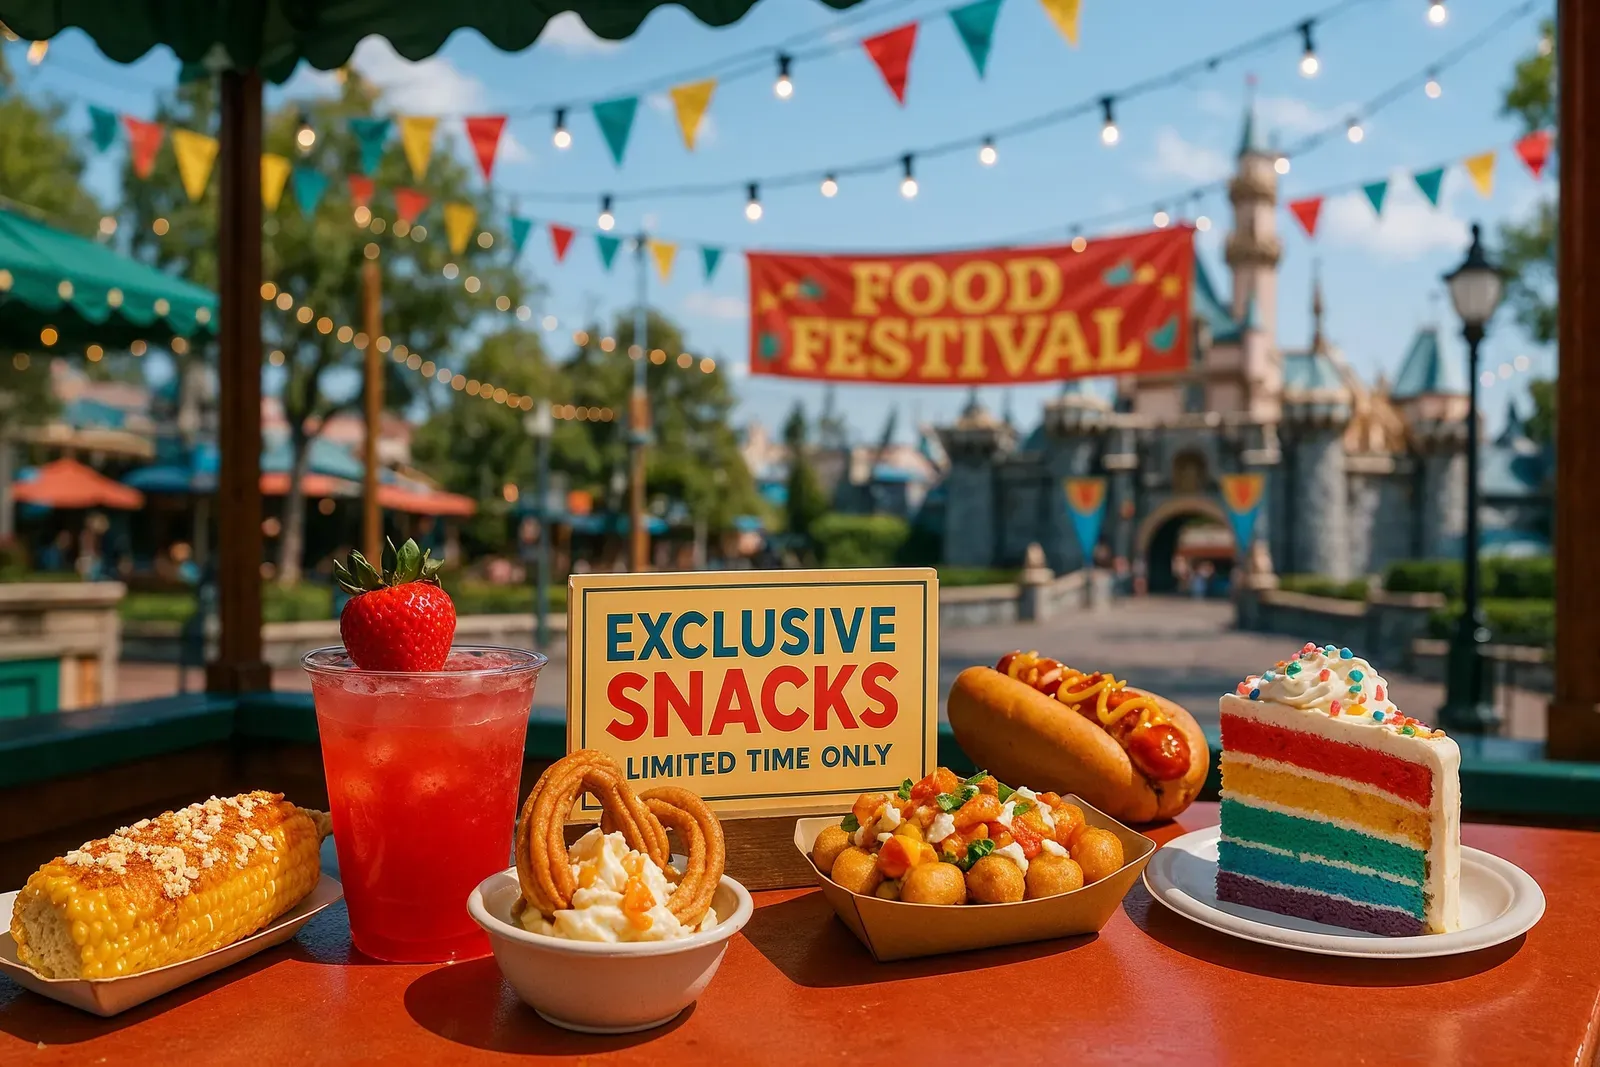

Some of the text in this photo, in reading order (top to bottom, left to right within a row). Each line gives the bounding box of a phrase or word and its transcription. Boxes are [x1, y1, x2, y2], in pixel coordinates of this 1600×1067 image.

[851, 258, 1063, 316] FOOD
[789, 308, 1141, 377] FESTIVAL
[607, 606, 896, 661] EXCLUSIVE
[605, 662, 899, 742] SNACKS
[627, 743, 893, 780] LIMITED TIME ONLY
